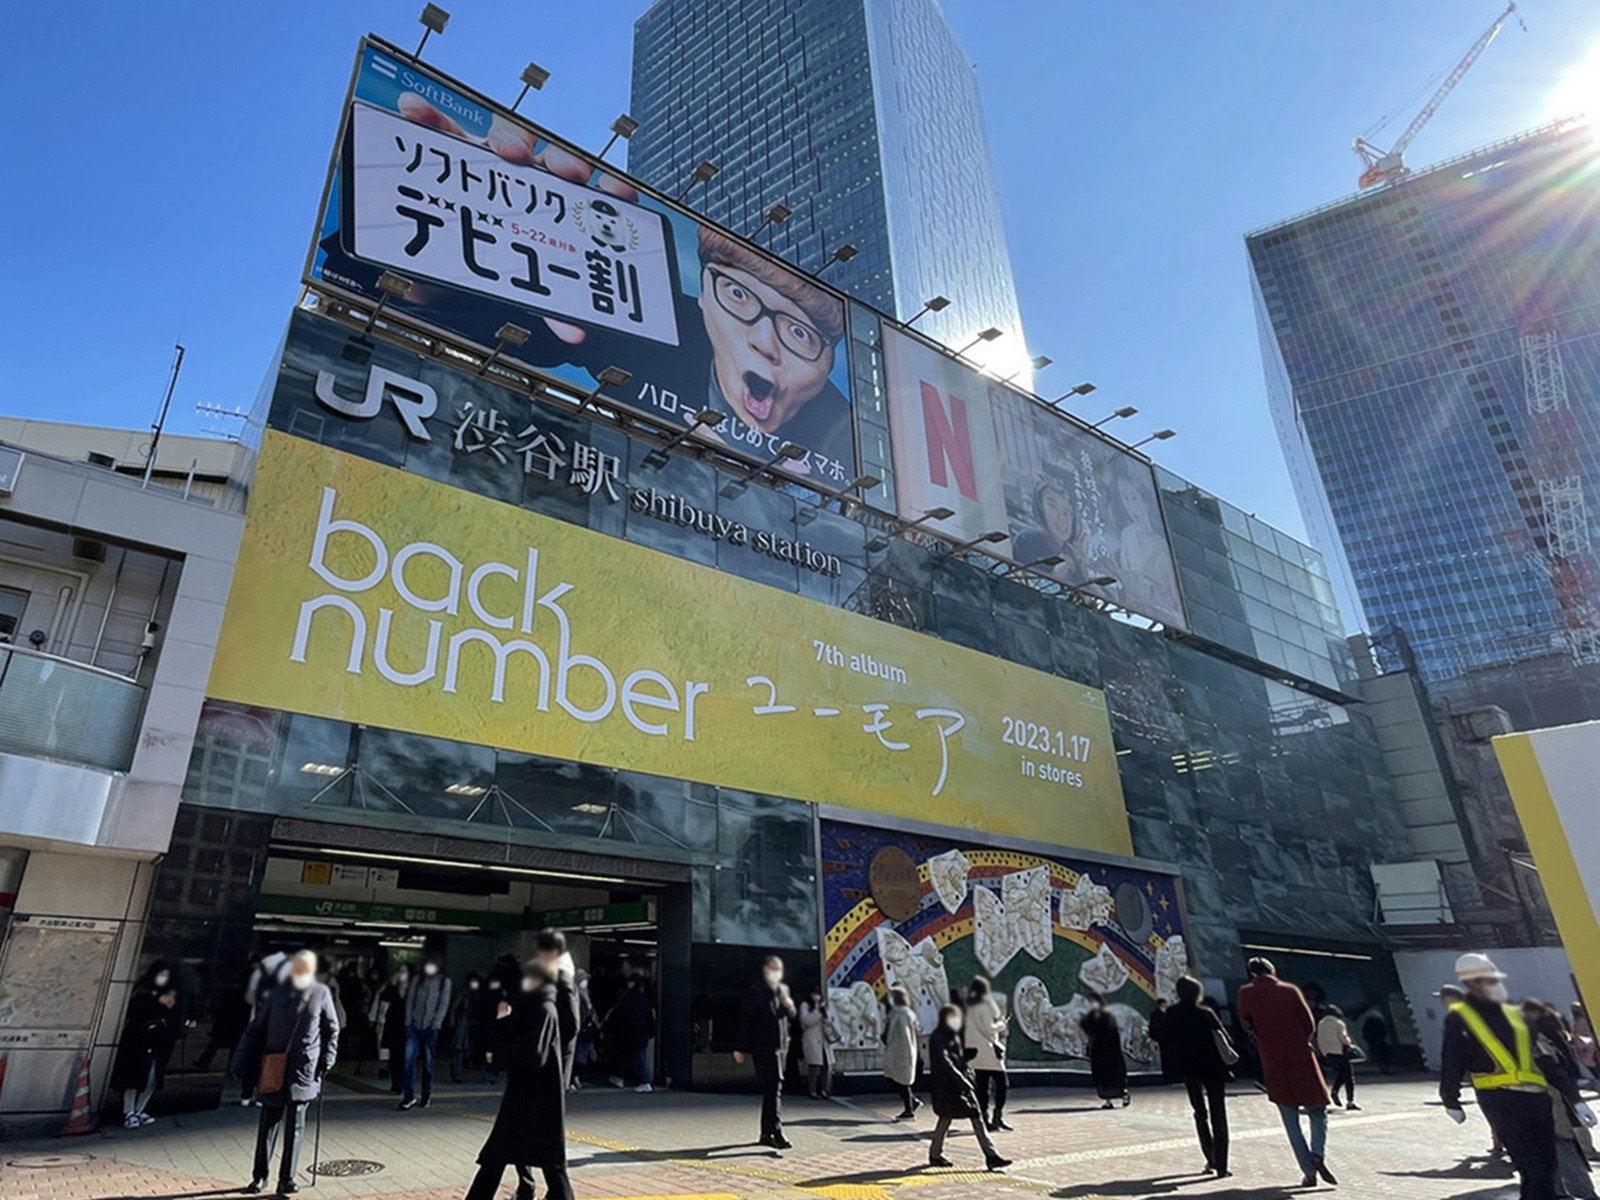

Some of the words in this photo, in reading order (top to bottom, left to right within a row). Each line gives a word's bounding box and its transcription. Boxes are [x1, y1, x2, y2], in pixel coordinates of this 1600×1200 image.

[400, 71, 485, 127] SoftBank
[395, 135, 567, 224] ソフトバンク
[395, 185, 644, 323] デビュー割
[314, 364, 438, 441] JR
[453, 401, 620, 502] 渋谷駅
[633, 487, 748, 545] shibuya
[756, 530, 842, 576] station
[920, 380, 978, 502] N
[309, 487, 575, 634] back
[289, 594, 709, 740] number
[813, 639, 845, 668] 7th
[850, 653, 908, 684] album
[746, 675, 966, 797] ユーモア
[1001, 716, 1091, 762] 2023.1.17
[1020, 756, 1035, 776] in
[1038, 761, 1084, 788] stores
